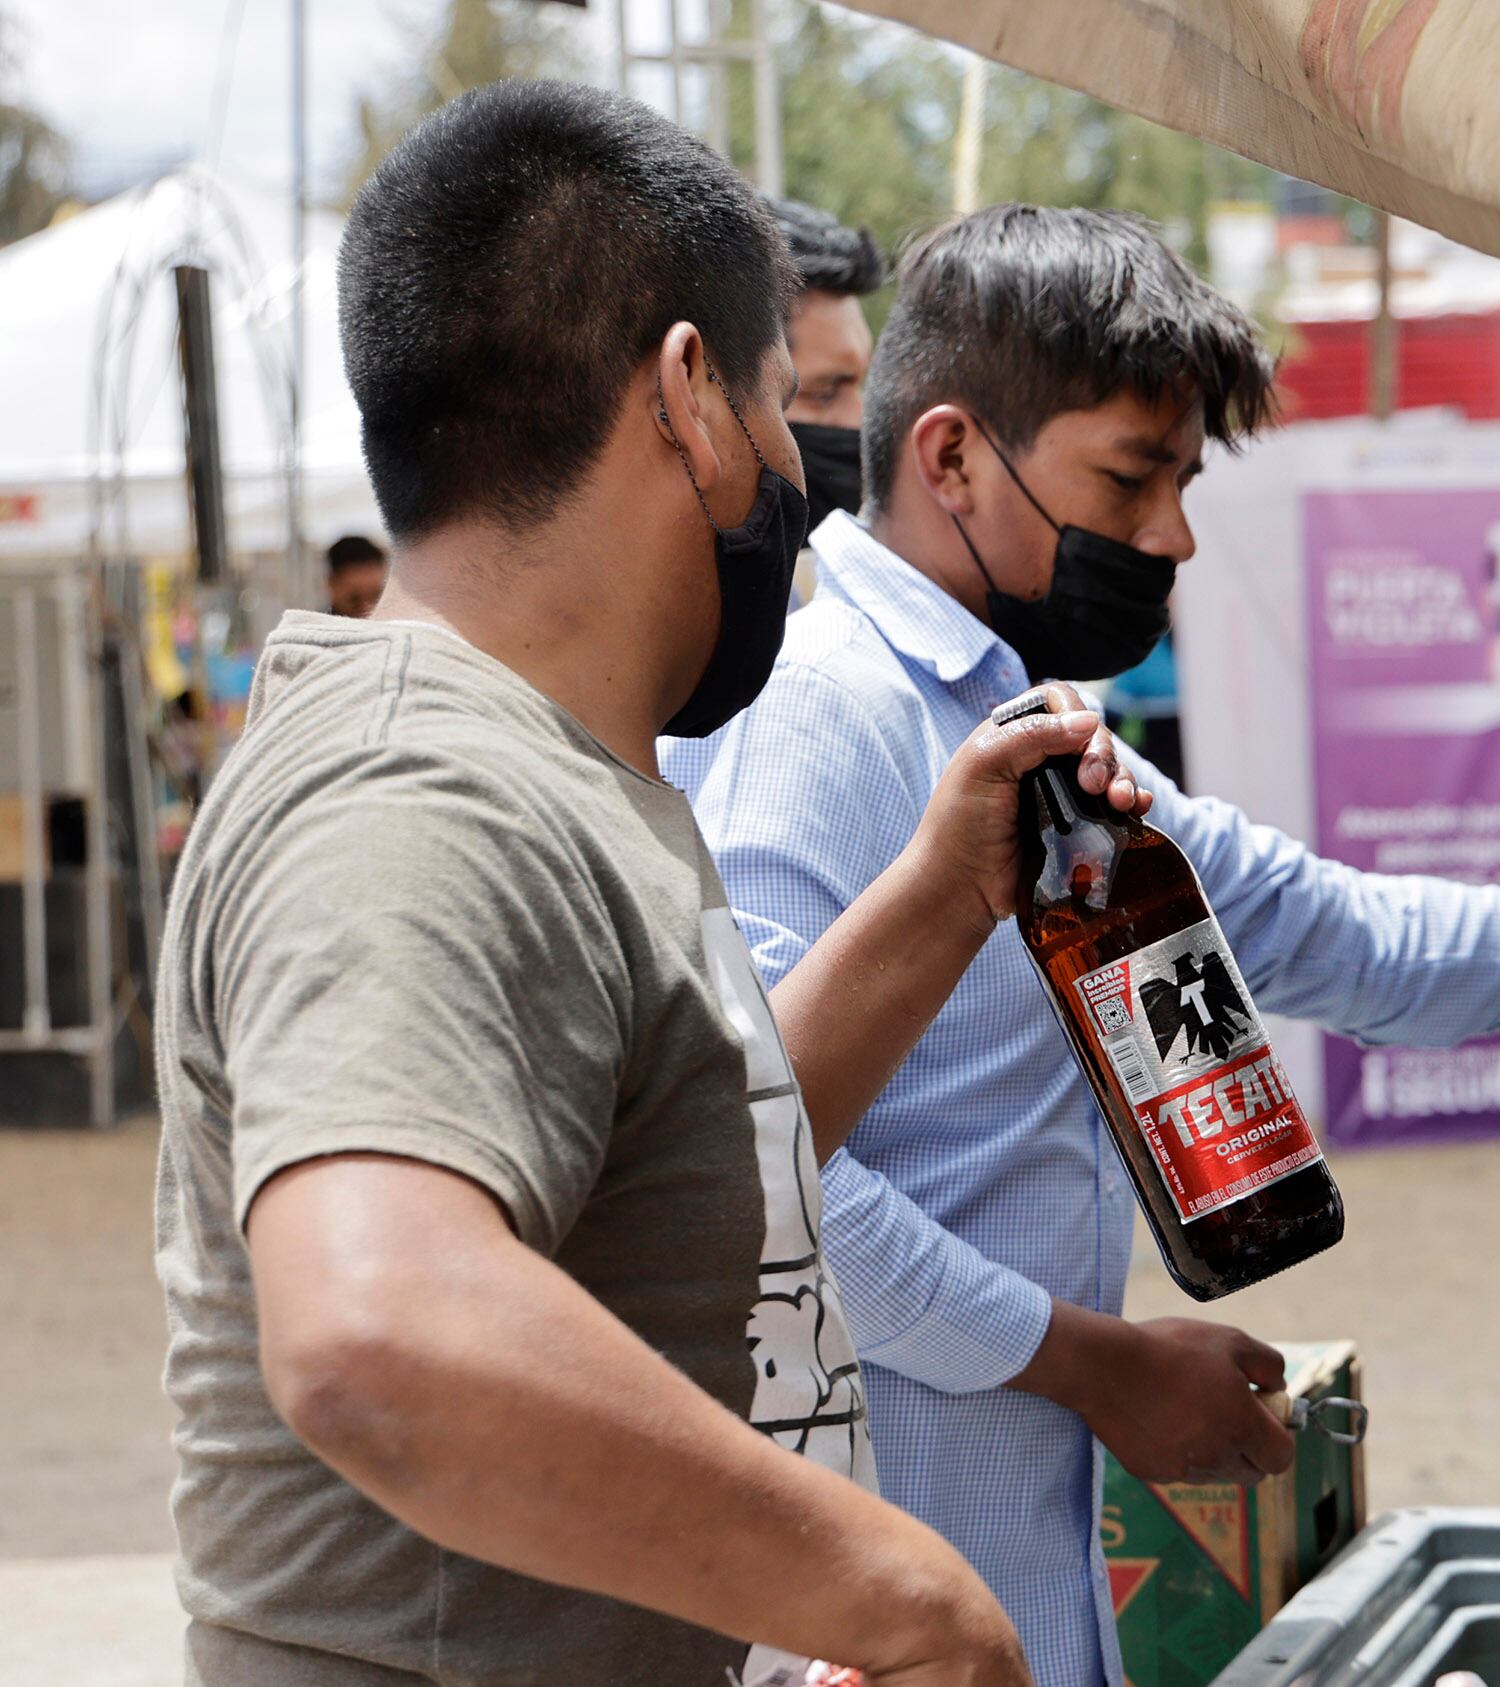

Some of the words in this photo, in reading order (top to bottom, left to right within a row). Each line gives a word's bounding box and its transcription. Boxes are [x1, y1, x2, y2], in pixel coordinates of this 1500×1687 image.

[1083, 966, 1126, 990] GANA
[1090, 983, 1126, 1004] PREMIOS
[1180, 978, 1214, 1026] T
[1151, 1130, 1163, 1145] NET.
[1216, 1115, 1293, 1157] ORIGINAL
[1158, 1144, 1171, 1164] CONT.
[1227, 1142, 1269, 1165] CERVEZA
[1188, 1201, 1197, 1213] EL
[1196, 1194, 1213, 1211] ABUSO
[1211, 1191, 1220, 1202] EN
[1218, 1188, 1227, 1199] EL
[1226, 1176, 1253, 1196] CONSUMO
[1251, 1172, 1261, 1185] DE
[1260, 1166, 1274, 1182] ESTE
[1270, 1155, 1295, 1176] PRODUCTO
